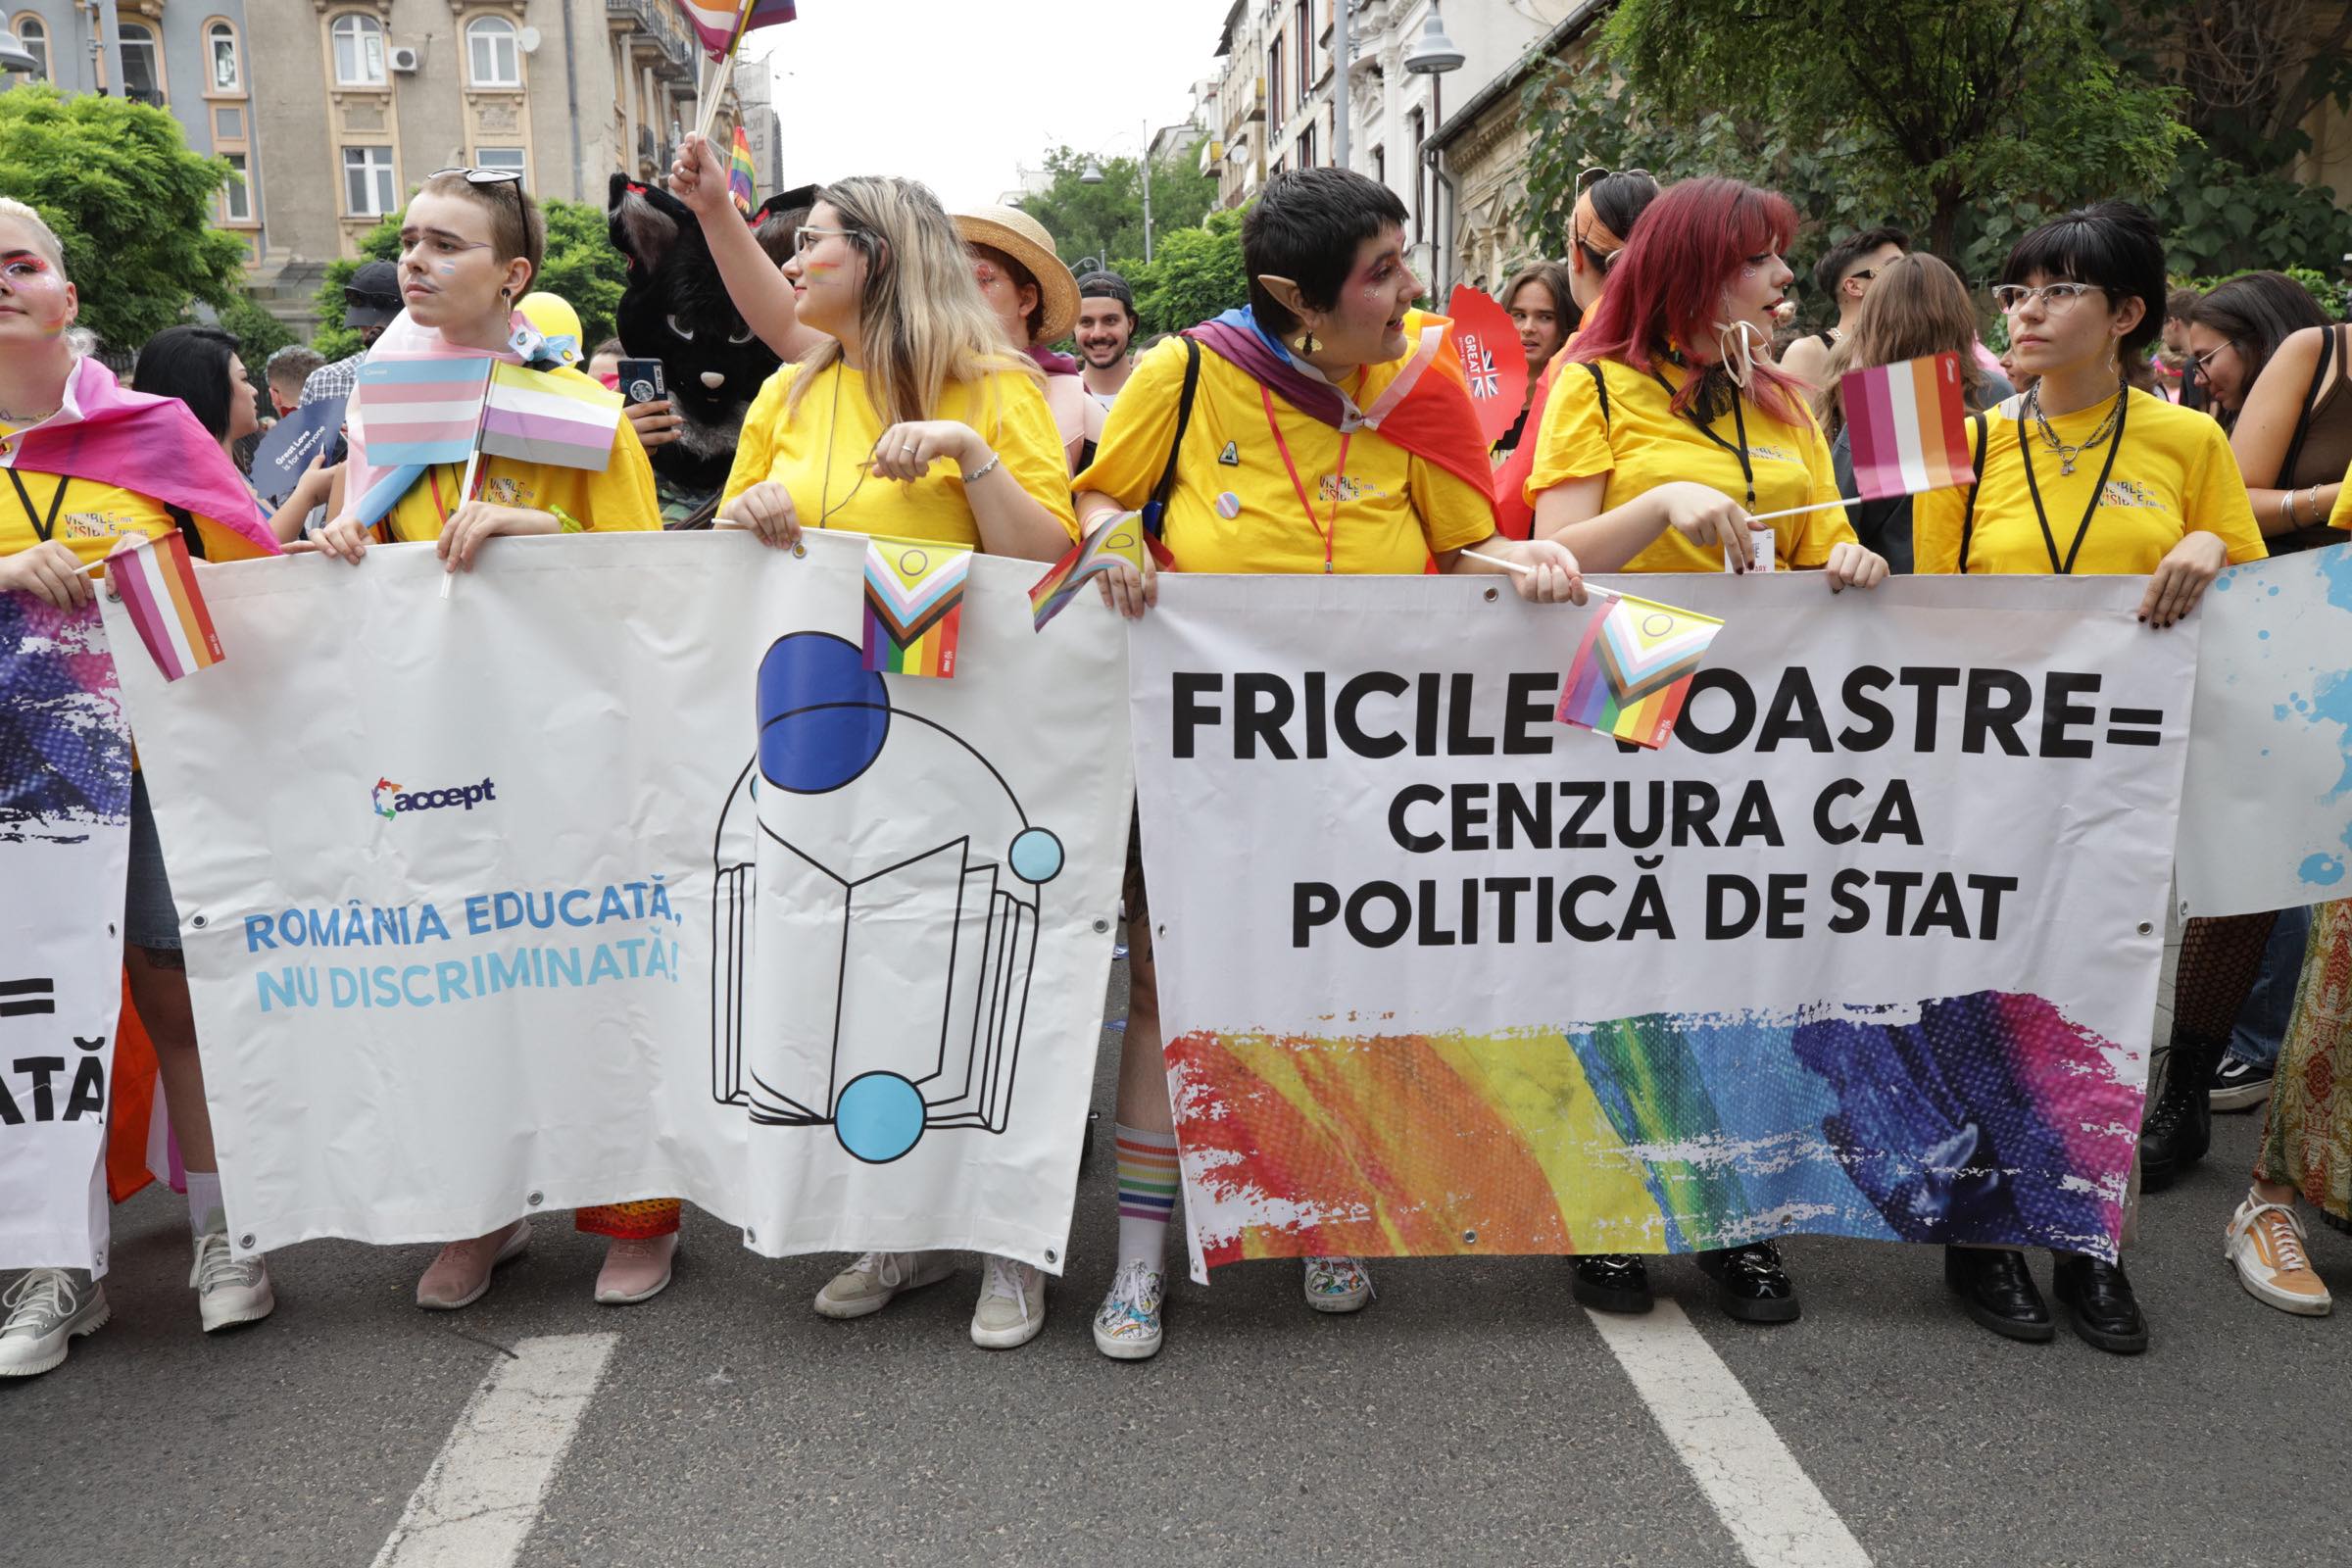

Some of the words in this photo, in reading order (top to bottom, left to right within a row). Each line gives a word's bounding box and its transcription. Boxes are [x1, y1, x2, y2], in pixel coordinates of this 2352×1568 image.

[1465, 334, 1481, 373] GREAT
[275, 445, 296, 466] Great
[293, 430, 311, 447] Love
[288, 455, 300, 466] for
[298, 425, 325, 456] everyone
[1172, 671, 1559, 760] FRICILE
[1612, 664, 2164, 759] OASTRE=
[394, 777, 496, 812] accept
[1388, 779, 1785, 854] CENZURA
[1812, 777, 1925, 845] CA
[244, 899, 451, 954] ROMÂNIA
[465, 874, 682, 936] EDUCATĂ,
[1292, 855, 1677, 948] POLITICĂ
[1705, 873, 1808, 941] DE
[1827, 867, 2019, 941] STAT
[256, 966, 319, 1012] NU
[330, 927, 679, 1009] DISCRIMINATĂ!
